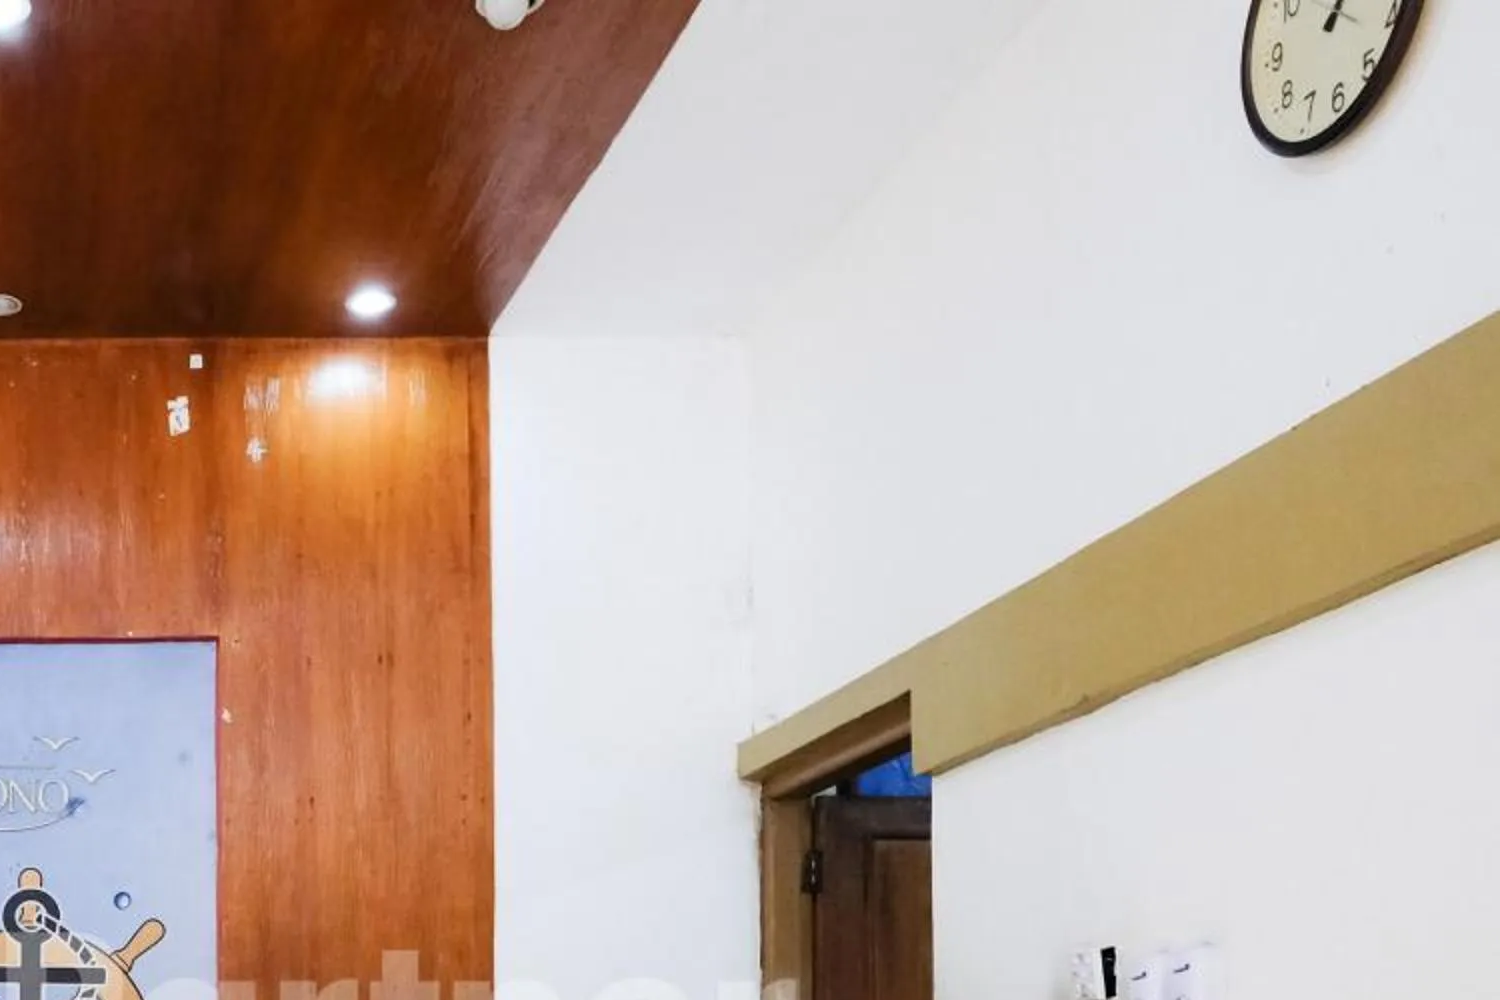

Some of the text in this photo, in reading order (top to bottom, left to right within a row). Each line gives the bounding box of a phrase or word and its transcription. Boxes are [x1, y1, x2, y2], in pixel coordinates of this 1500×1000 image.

[1271, 42, 1283, 72] 9
[1361, 48, 1376, 82] 5
[1281, 79, 1294, 109] 8
[1303, 89, 1317, 122] 7
[1331, 81, 1346, 113] 6
